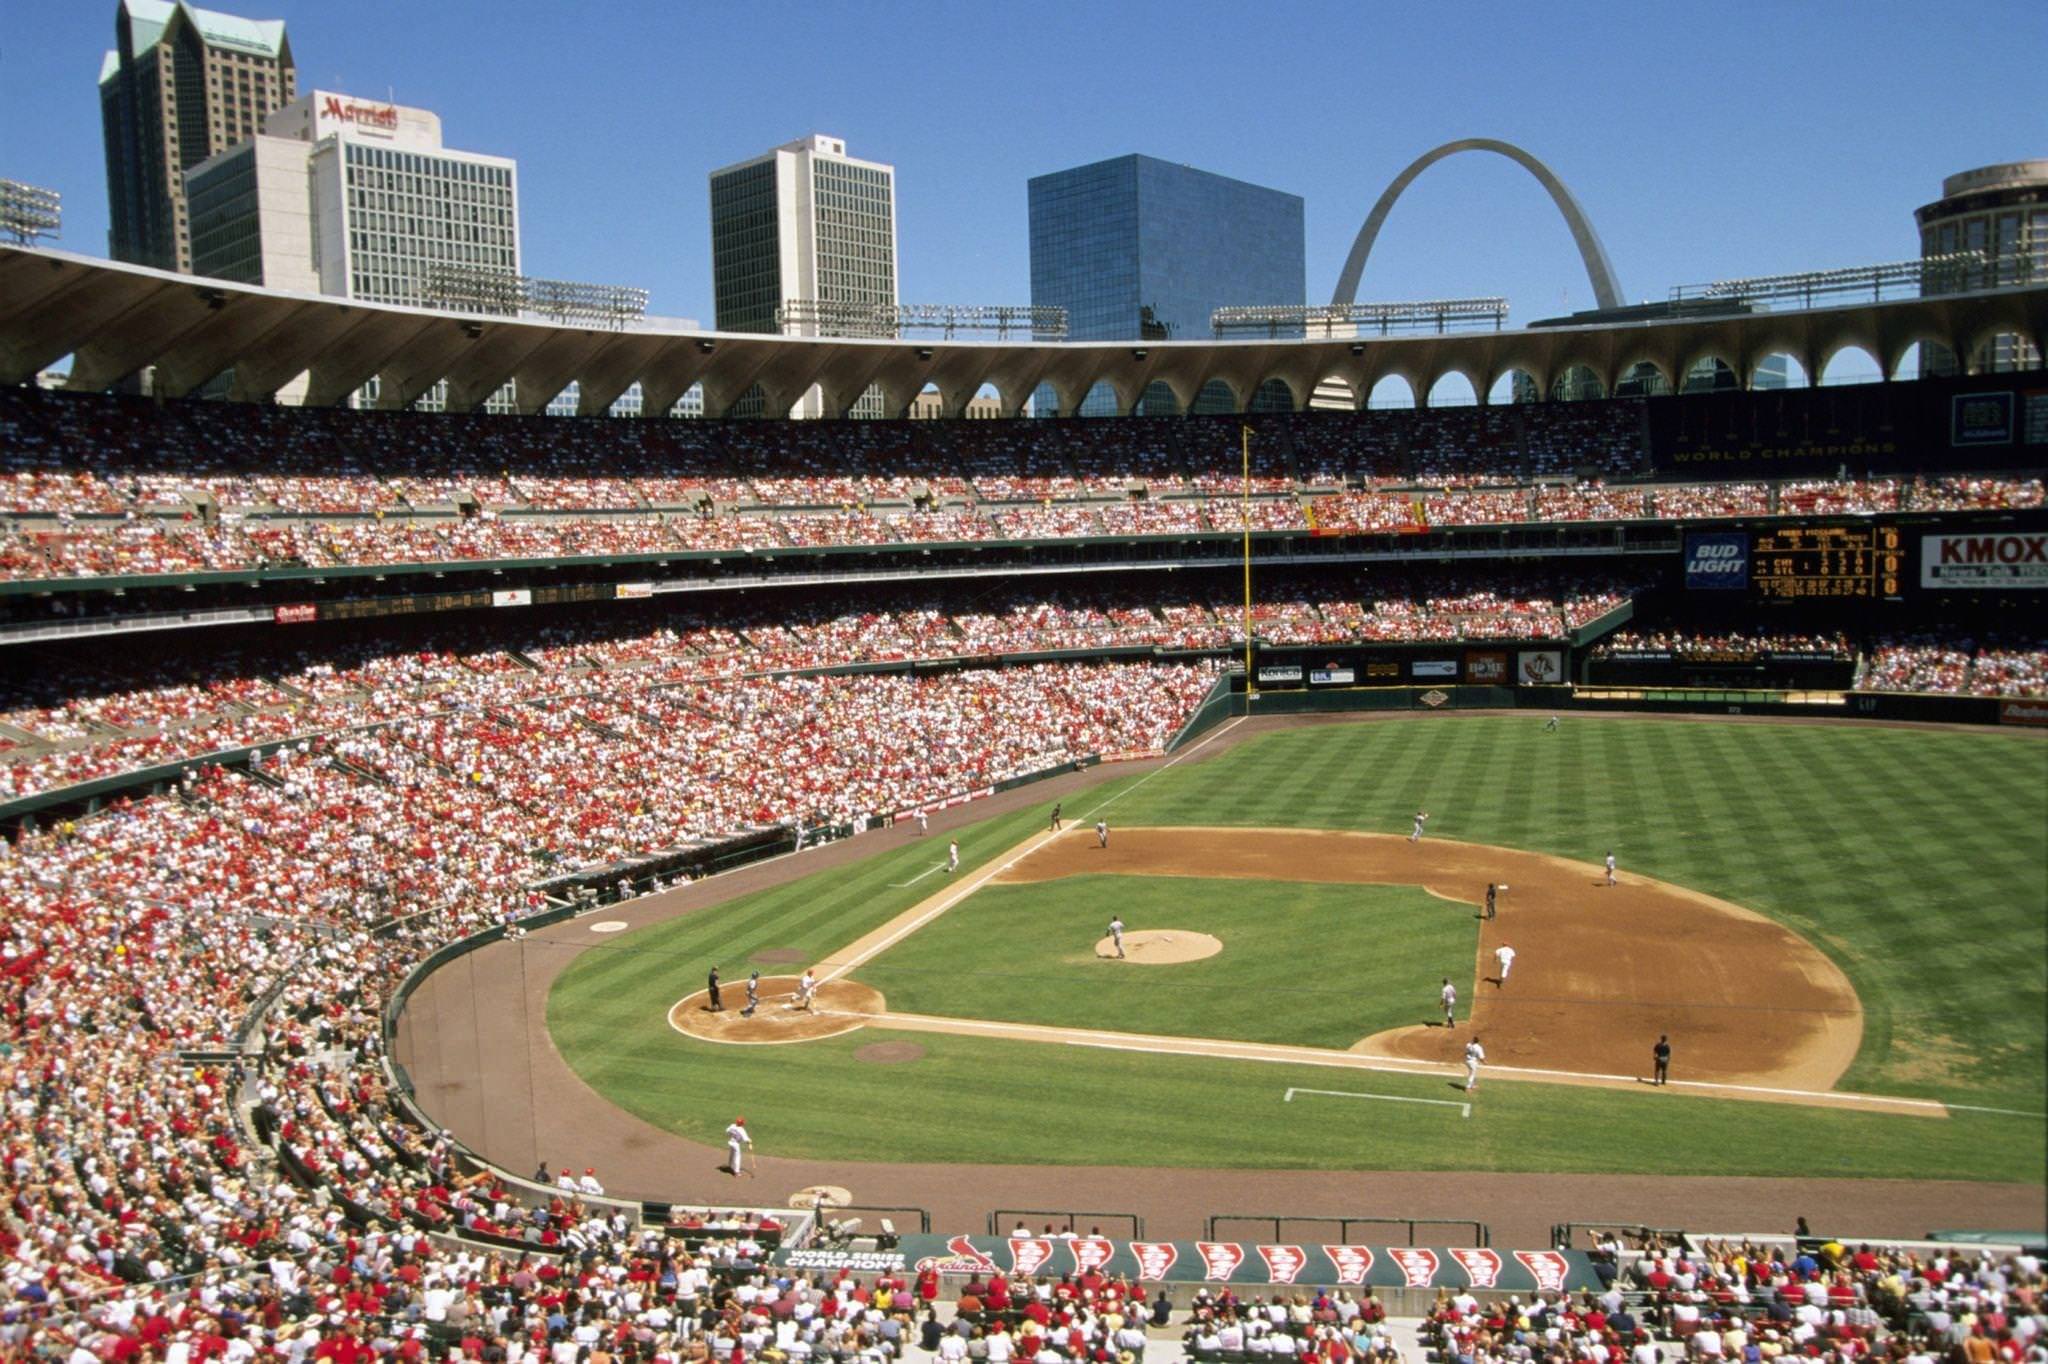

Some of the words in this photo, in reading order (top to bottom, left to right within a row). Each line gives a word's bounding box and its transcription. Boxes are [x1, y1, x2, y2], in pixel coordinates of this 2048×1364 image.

[320, 96, 398, 126] Marriott
[1673, 450, 1752, 463] WORLD
[1760, 442, 1897, 460] CHAMPIONS
[1696, 545, 1738, 558] BUD
[1941, 536, 2048, 563] KMOX
[1687, 560, 1744, 573] LIGHT
[791, 1250, 848, 1259] WORLD
[851, 1251, 905, 1261] SERIES
[785, 1257, 905, 1271] CHAMPIONS
